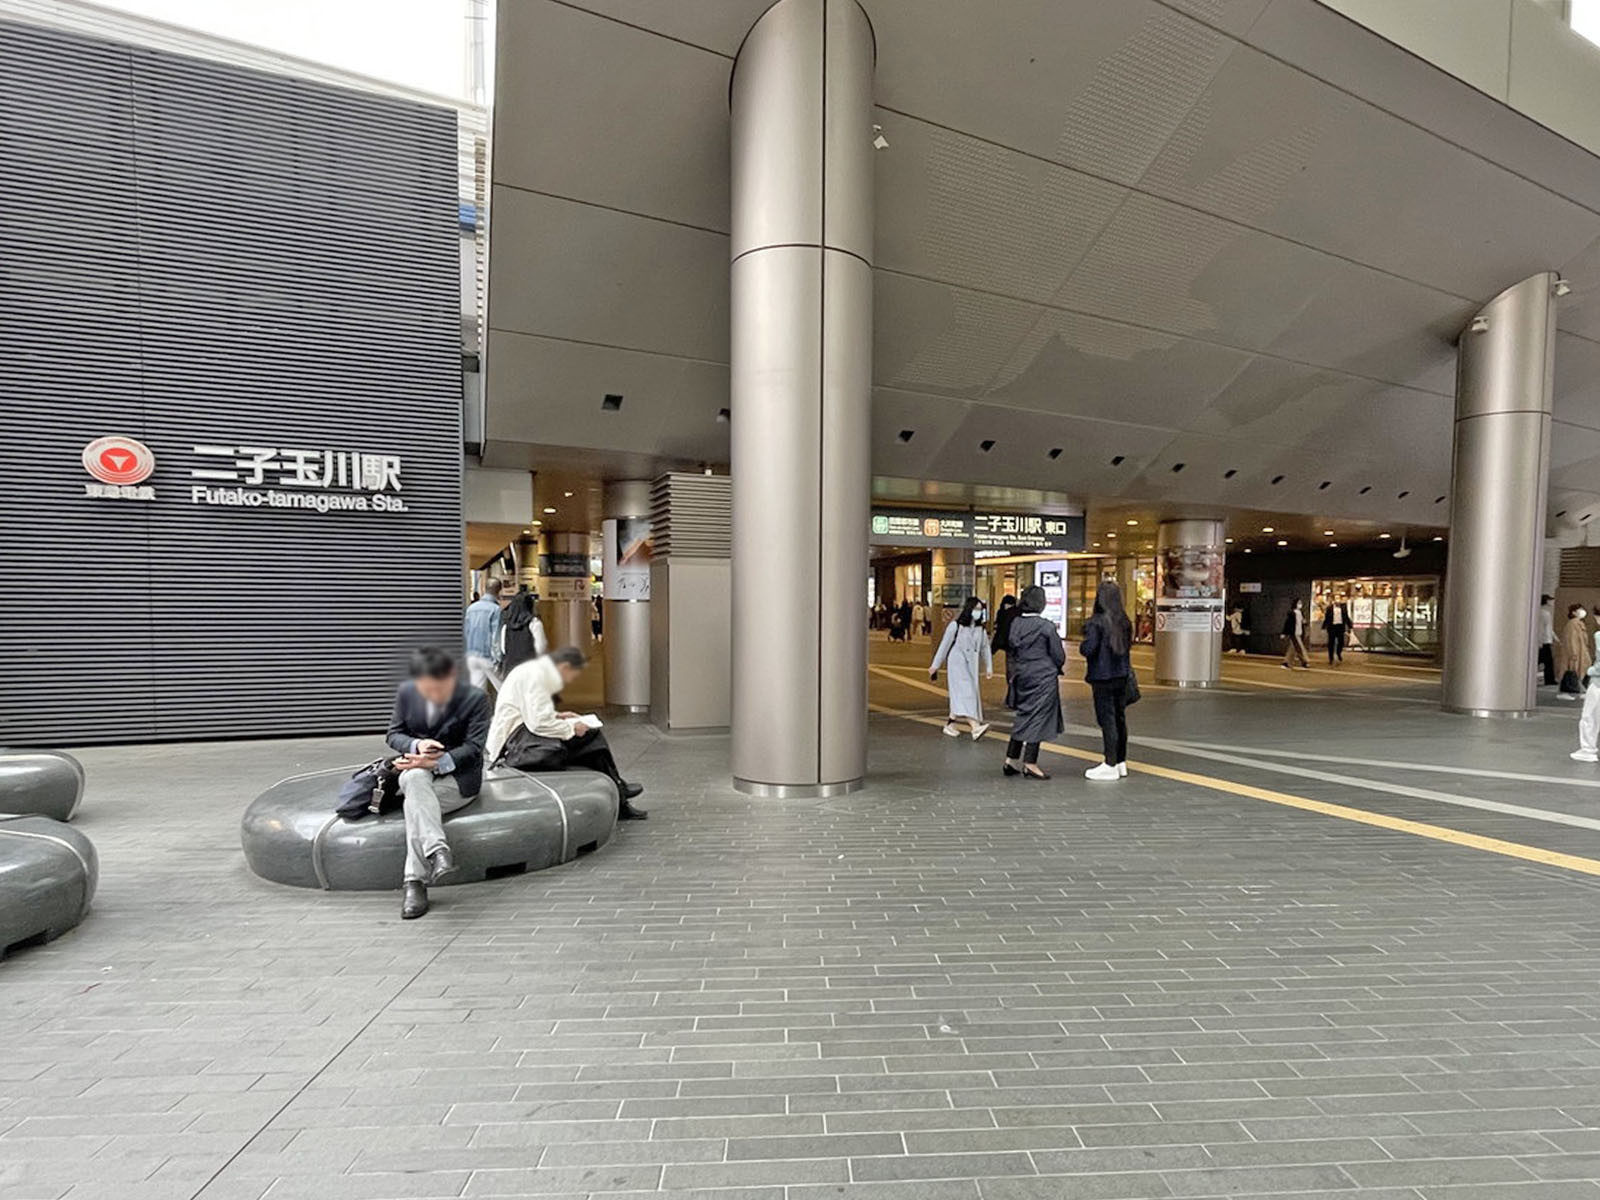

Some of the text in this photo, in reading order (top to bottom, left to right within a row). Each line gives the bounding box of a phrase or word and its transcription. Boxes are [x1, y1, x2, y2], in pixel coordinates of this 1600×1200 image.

[191, 445, 403, 492] 二子玉川駅
[191, 486, 409, 513] Futako-tamagawa Sta.
[973, 515, 1043, 534] 二子玉川駅
[1045, 521, 1067, 535] 東口
